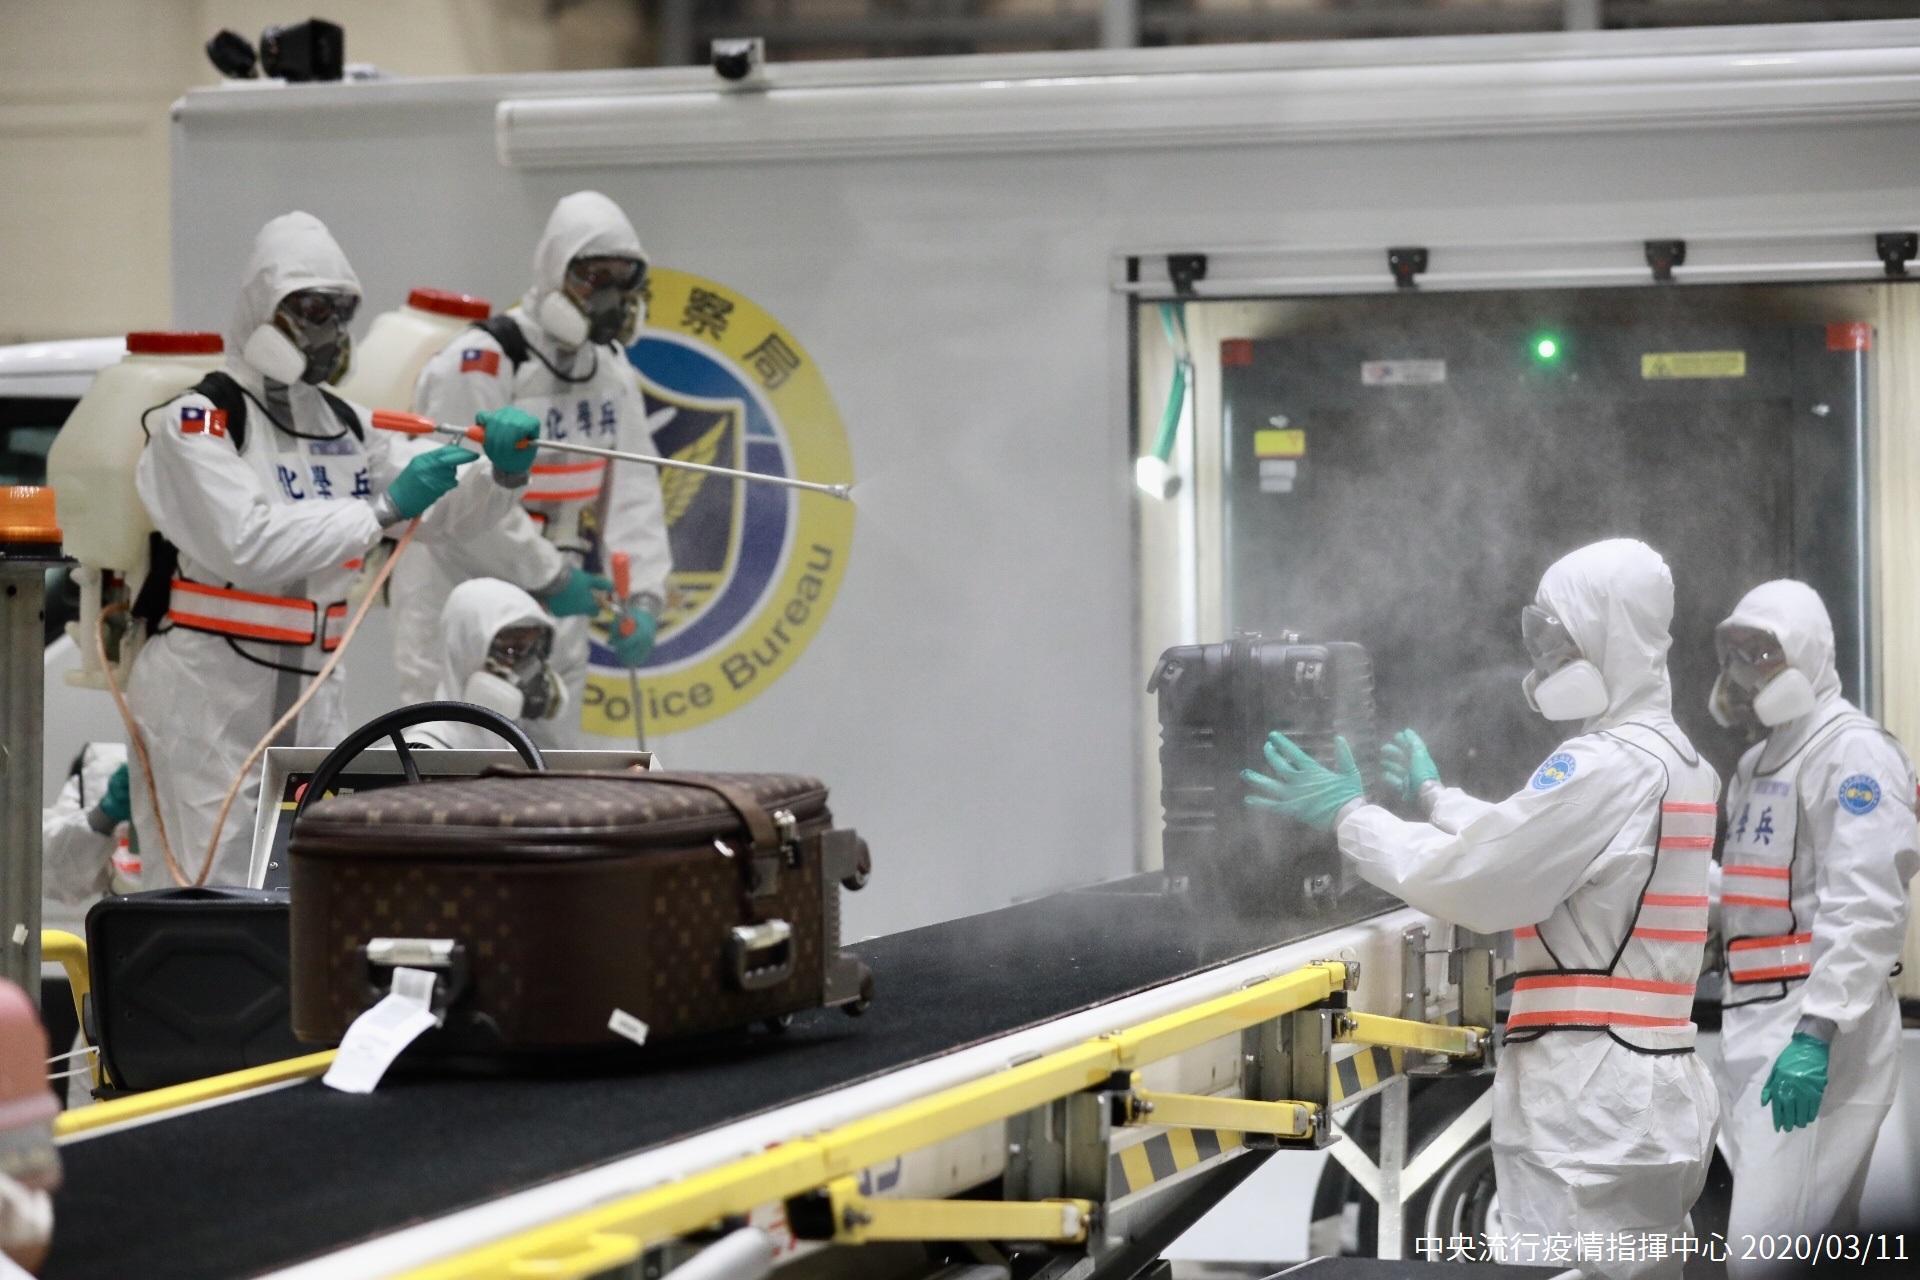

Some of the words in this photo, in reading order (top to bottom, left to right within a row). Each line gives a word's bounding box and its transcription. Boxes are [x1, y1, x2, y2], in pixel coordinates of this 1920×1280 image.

[643, 278, 801, 390] 察局
[583, 682, 714, 722] Poice
[719, 543, 833, 690] Bureau
